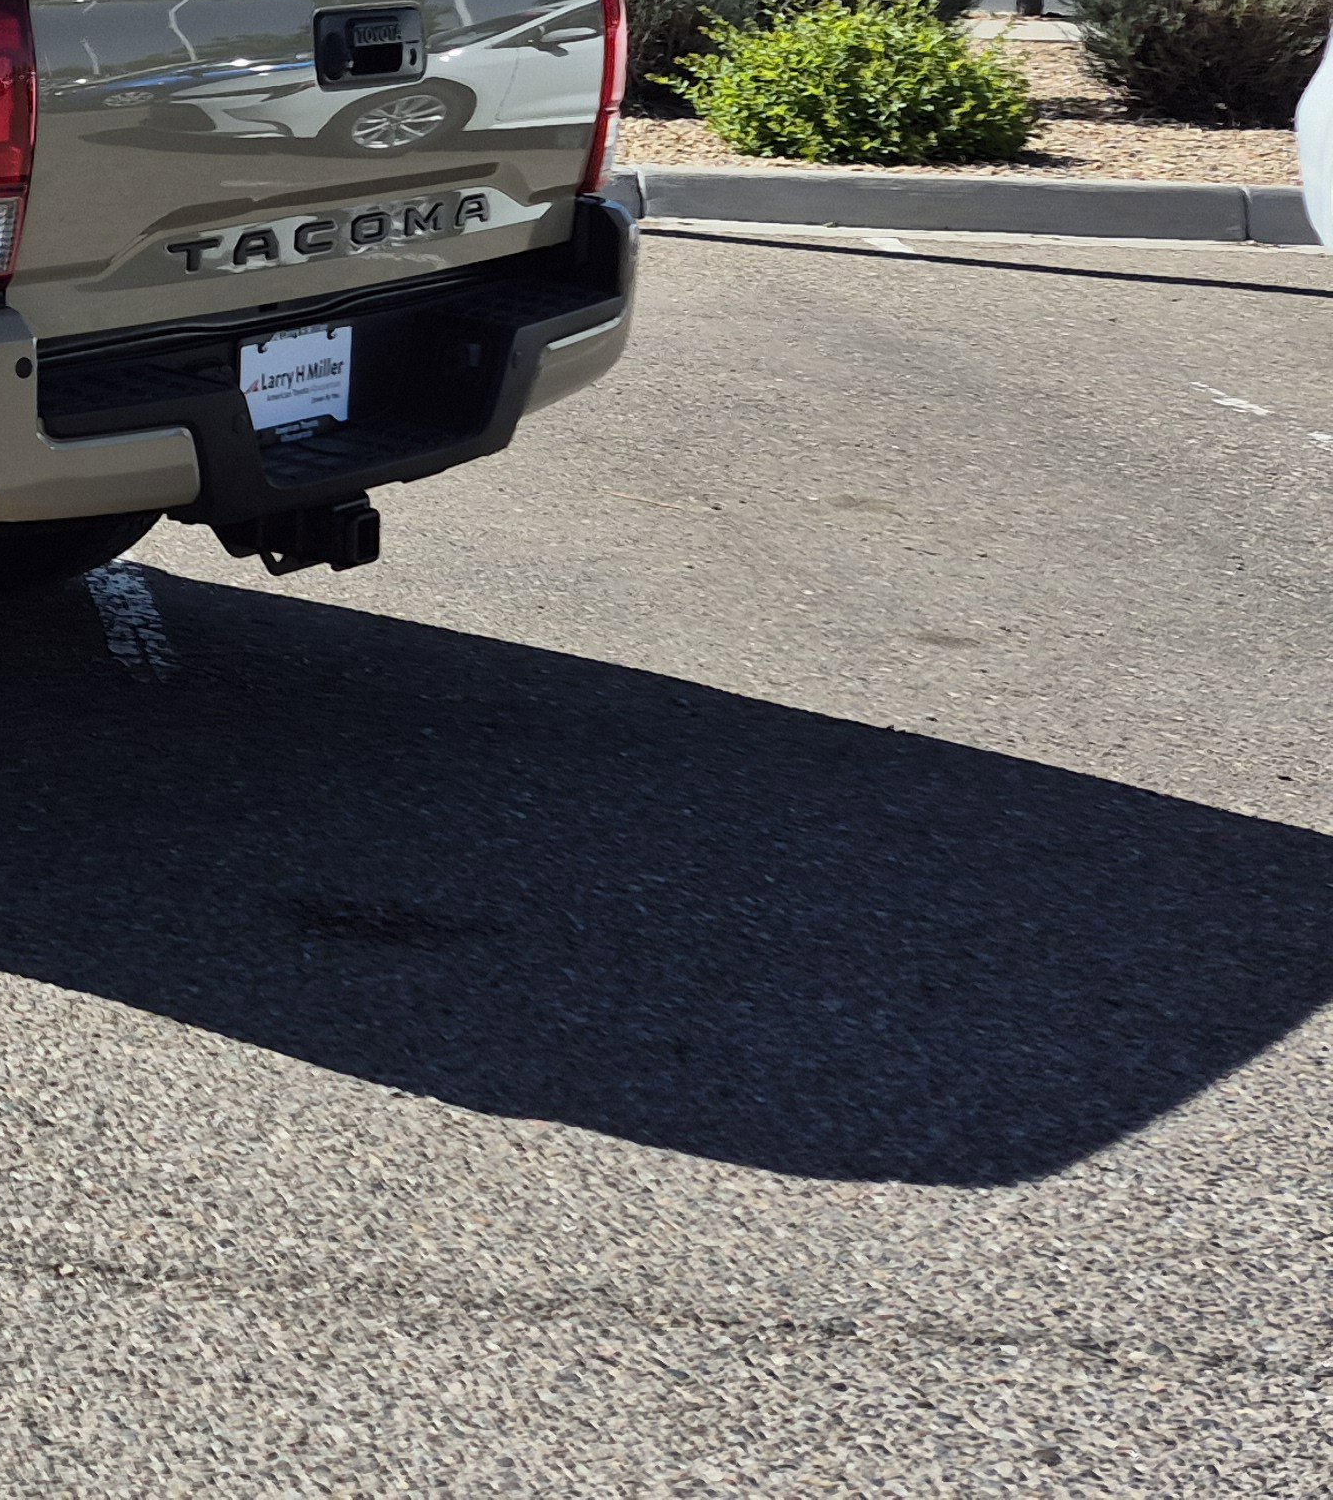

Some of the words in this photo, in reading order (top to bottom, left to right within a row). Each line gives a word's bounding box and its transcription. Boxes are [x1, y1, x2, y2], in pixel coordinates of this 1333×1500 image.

[165, 192, 490, 274] TACOMA
[261, 371, 295, 390] Larry
[295, 364, 306, 383] H
[307, 357, 345, 381] Miller
